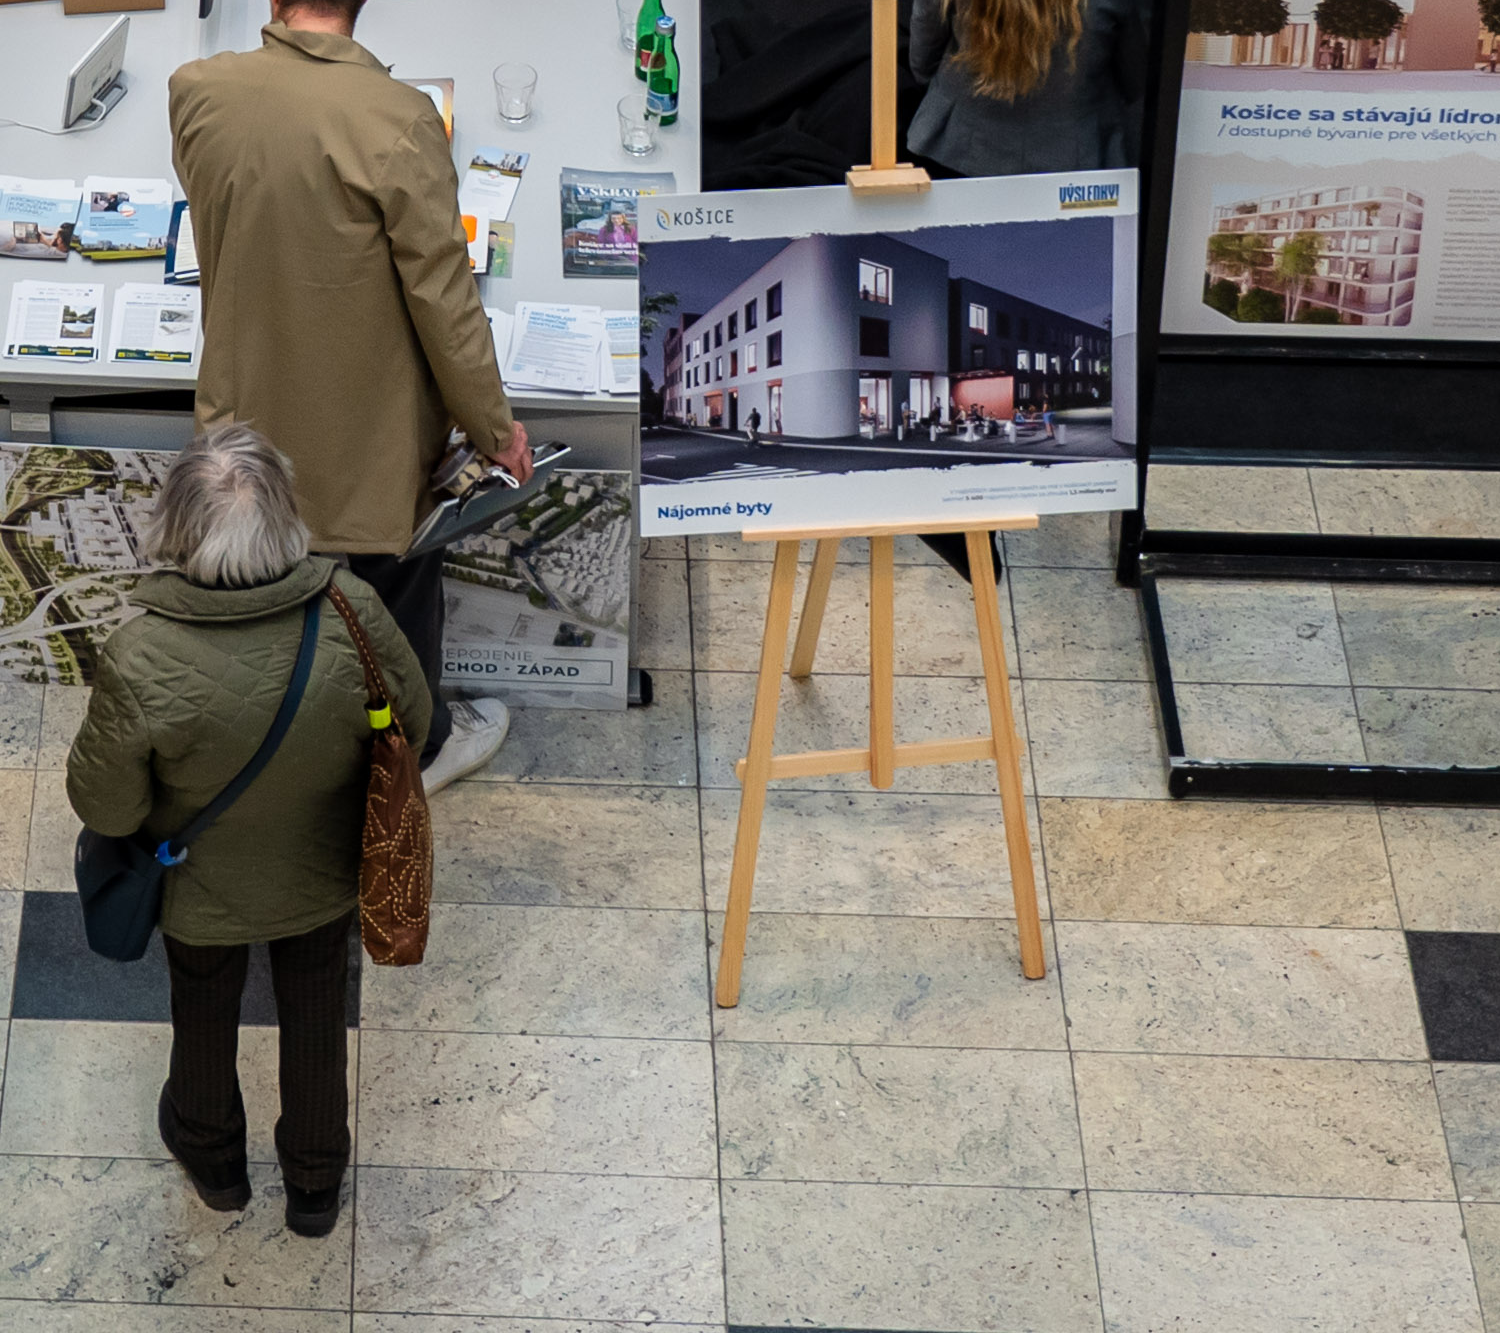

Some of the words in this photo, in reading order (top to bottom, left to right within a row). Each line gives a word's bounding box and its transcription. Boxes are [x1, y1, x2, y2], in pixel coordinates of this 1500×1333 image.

[1220, 104, 1301, 121] Košice
[1308, 108, 1335, 121] sa
[1341, 106, 1431, 126] stávajú
[1228, 124, 1312, 139] dostupné
[1317, 126, 1384, 142] bývanie
[1388, 129, 1416, 142] pre
[1421, 128, 1497, 144] všetkých
[674, 207, 735, 226] KOŠICE
[657, 502, 731, 520] Nájomné
[736, 501, 773, 516] byty
[445, 647, 533, 662] EPOJENIE
[517, 662, 580, 677] ZÁPAD
